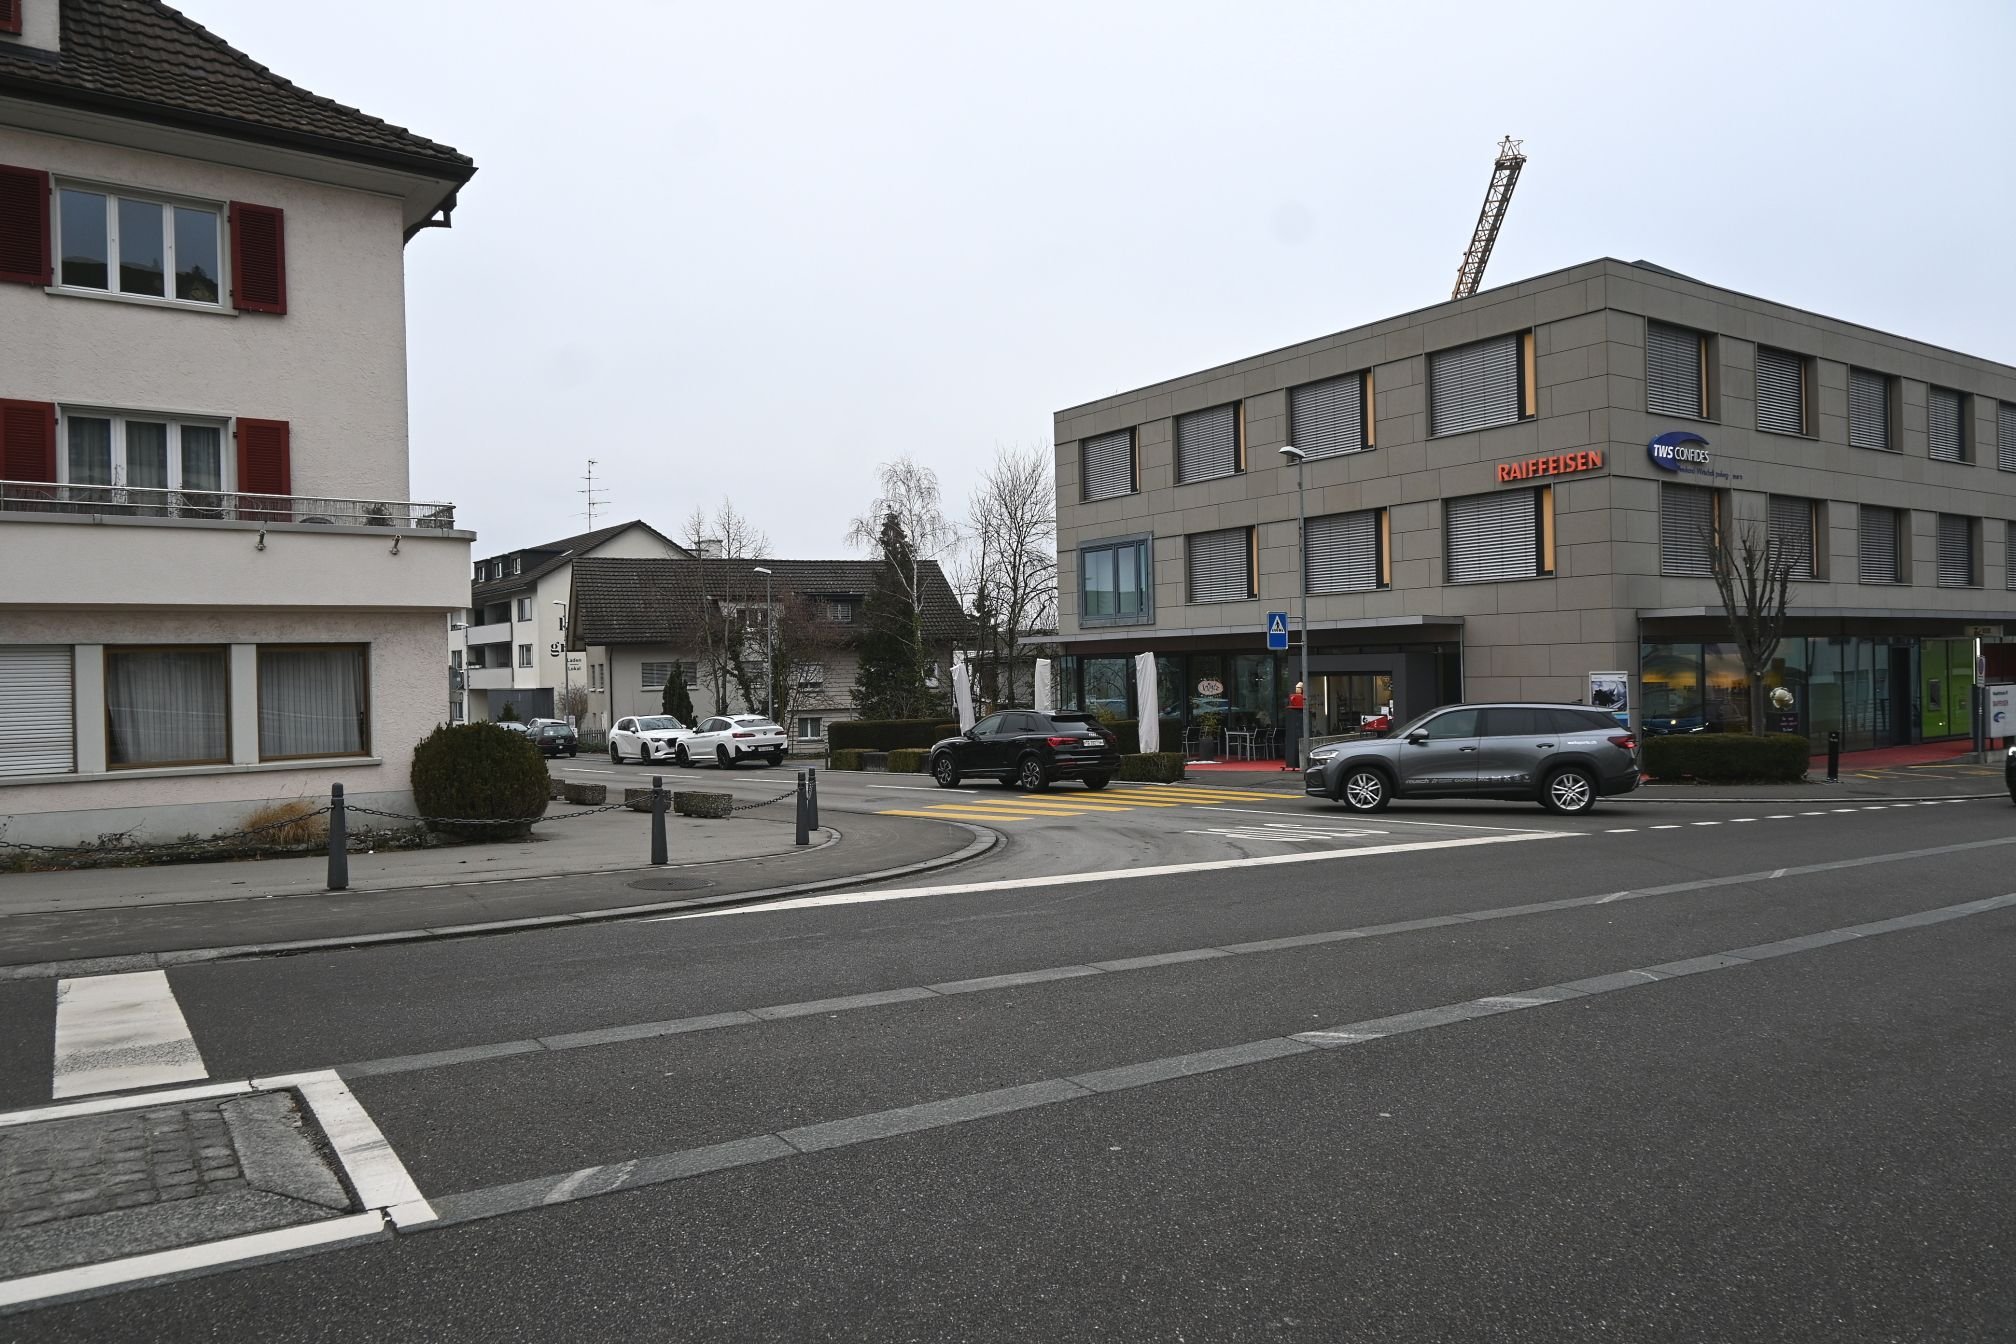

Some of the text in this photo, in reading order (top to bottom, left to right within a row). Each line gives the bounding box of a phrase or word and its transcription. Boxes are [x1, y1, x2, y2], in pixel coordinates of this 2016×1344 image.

[1497, 449, 1603, 481] RAIFFEISEN
[1653, 444, 1710, 463] TWS CONFIDES
